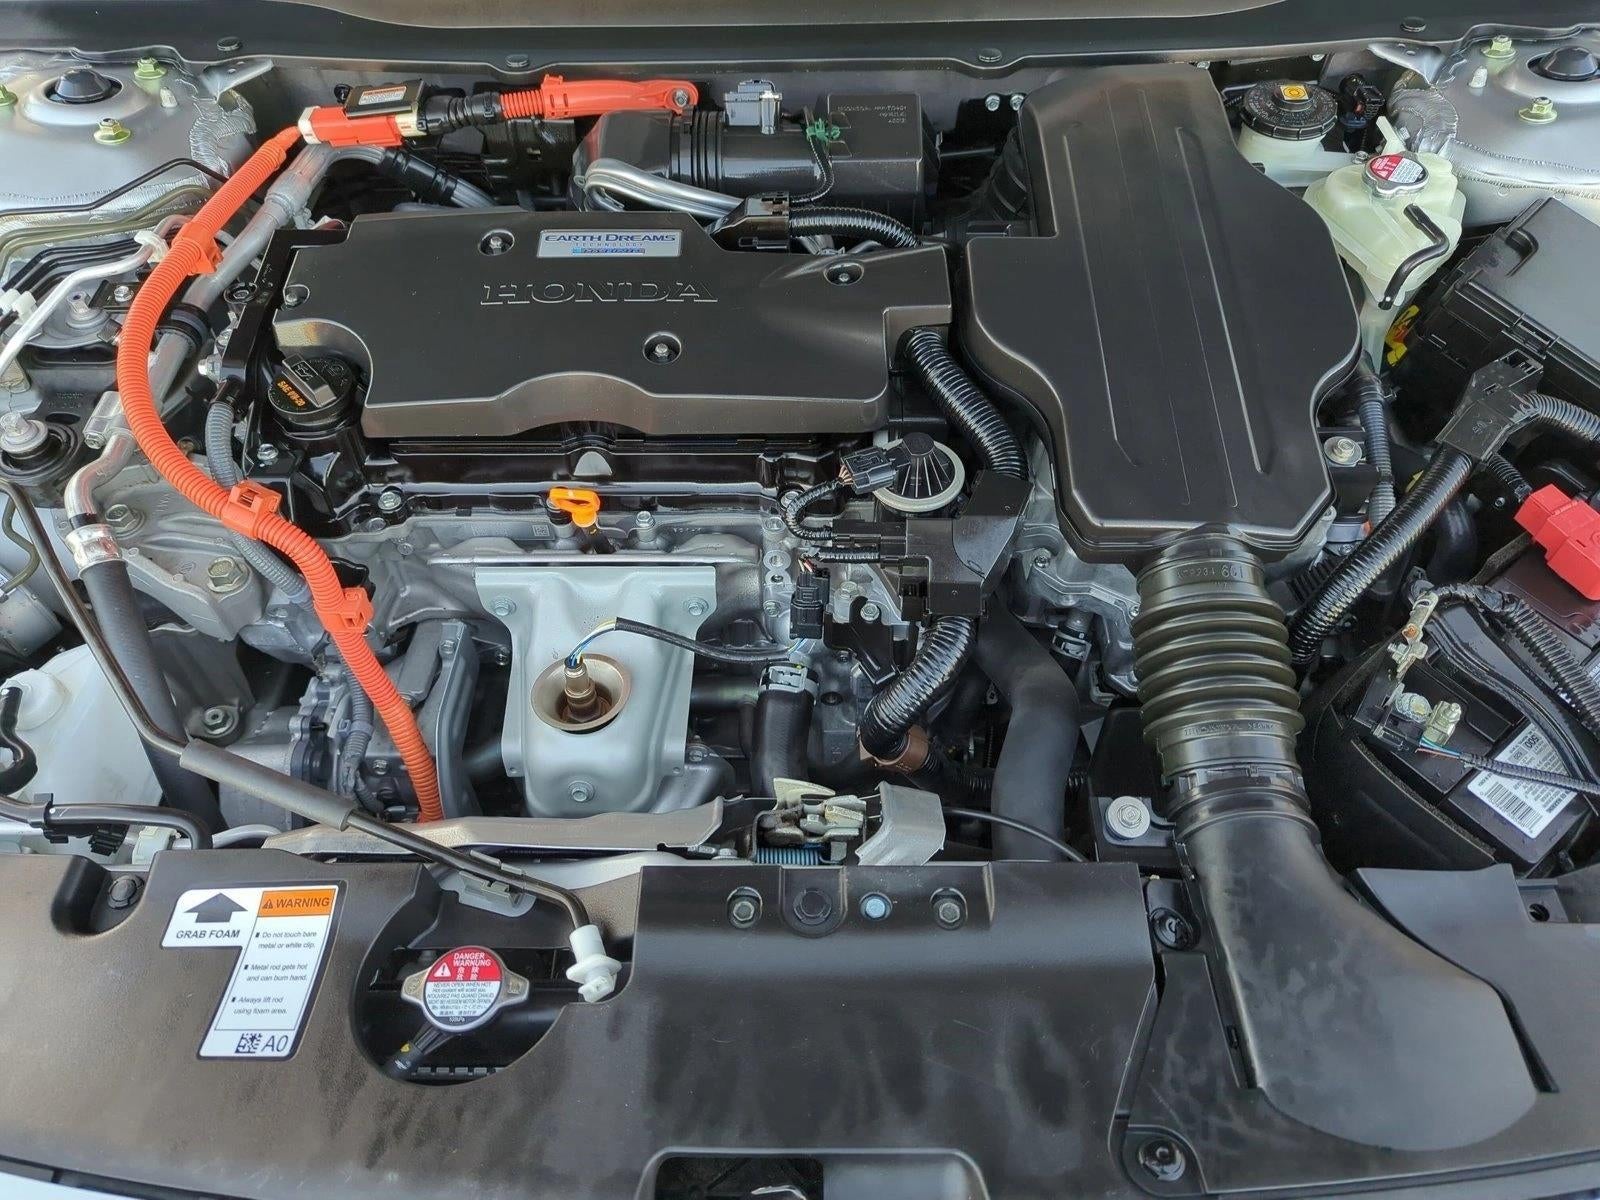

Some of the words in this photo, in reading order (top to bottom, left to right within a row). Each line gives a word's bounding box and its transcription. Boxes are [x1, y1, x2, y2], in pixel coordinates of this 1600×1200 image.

[544, 234, 602, 242] EARTH
[605, 233, 676, 242] DREAMS
[480, 282, 718, 305] HONDA
[276, 896, 330, 908] WARNING
[176, 930, 206, 938] GRAB
[208, 929, 240, 938] FOAM
[233, 1008, 252, 1016] using
